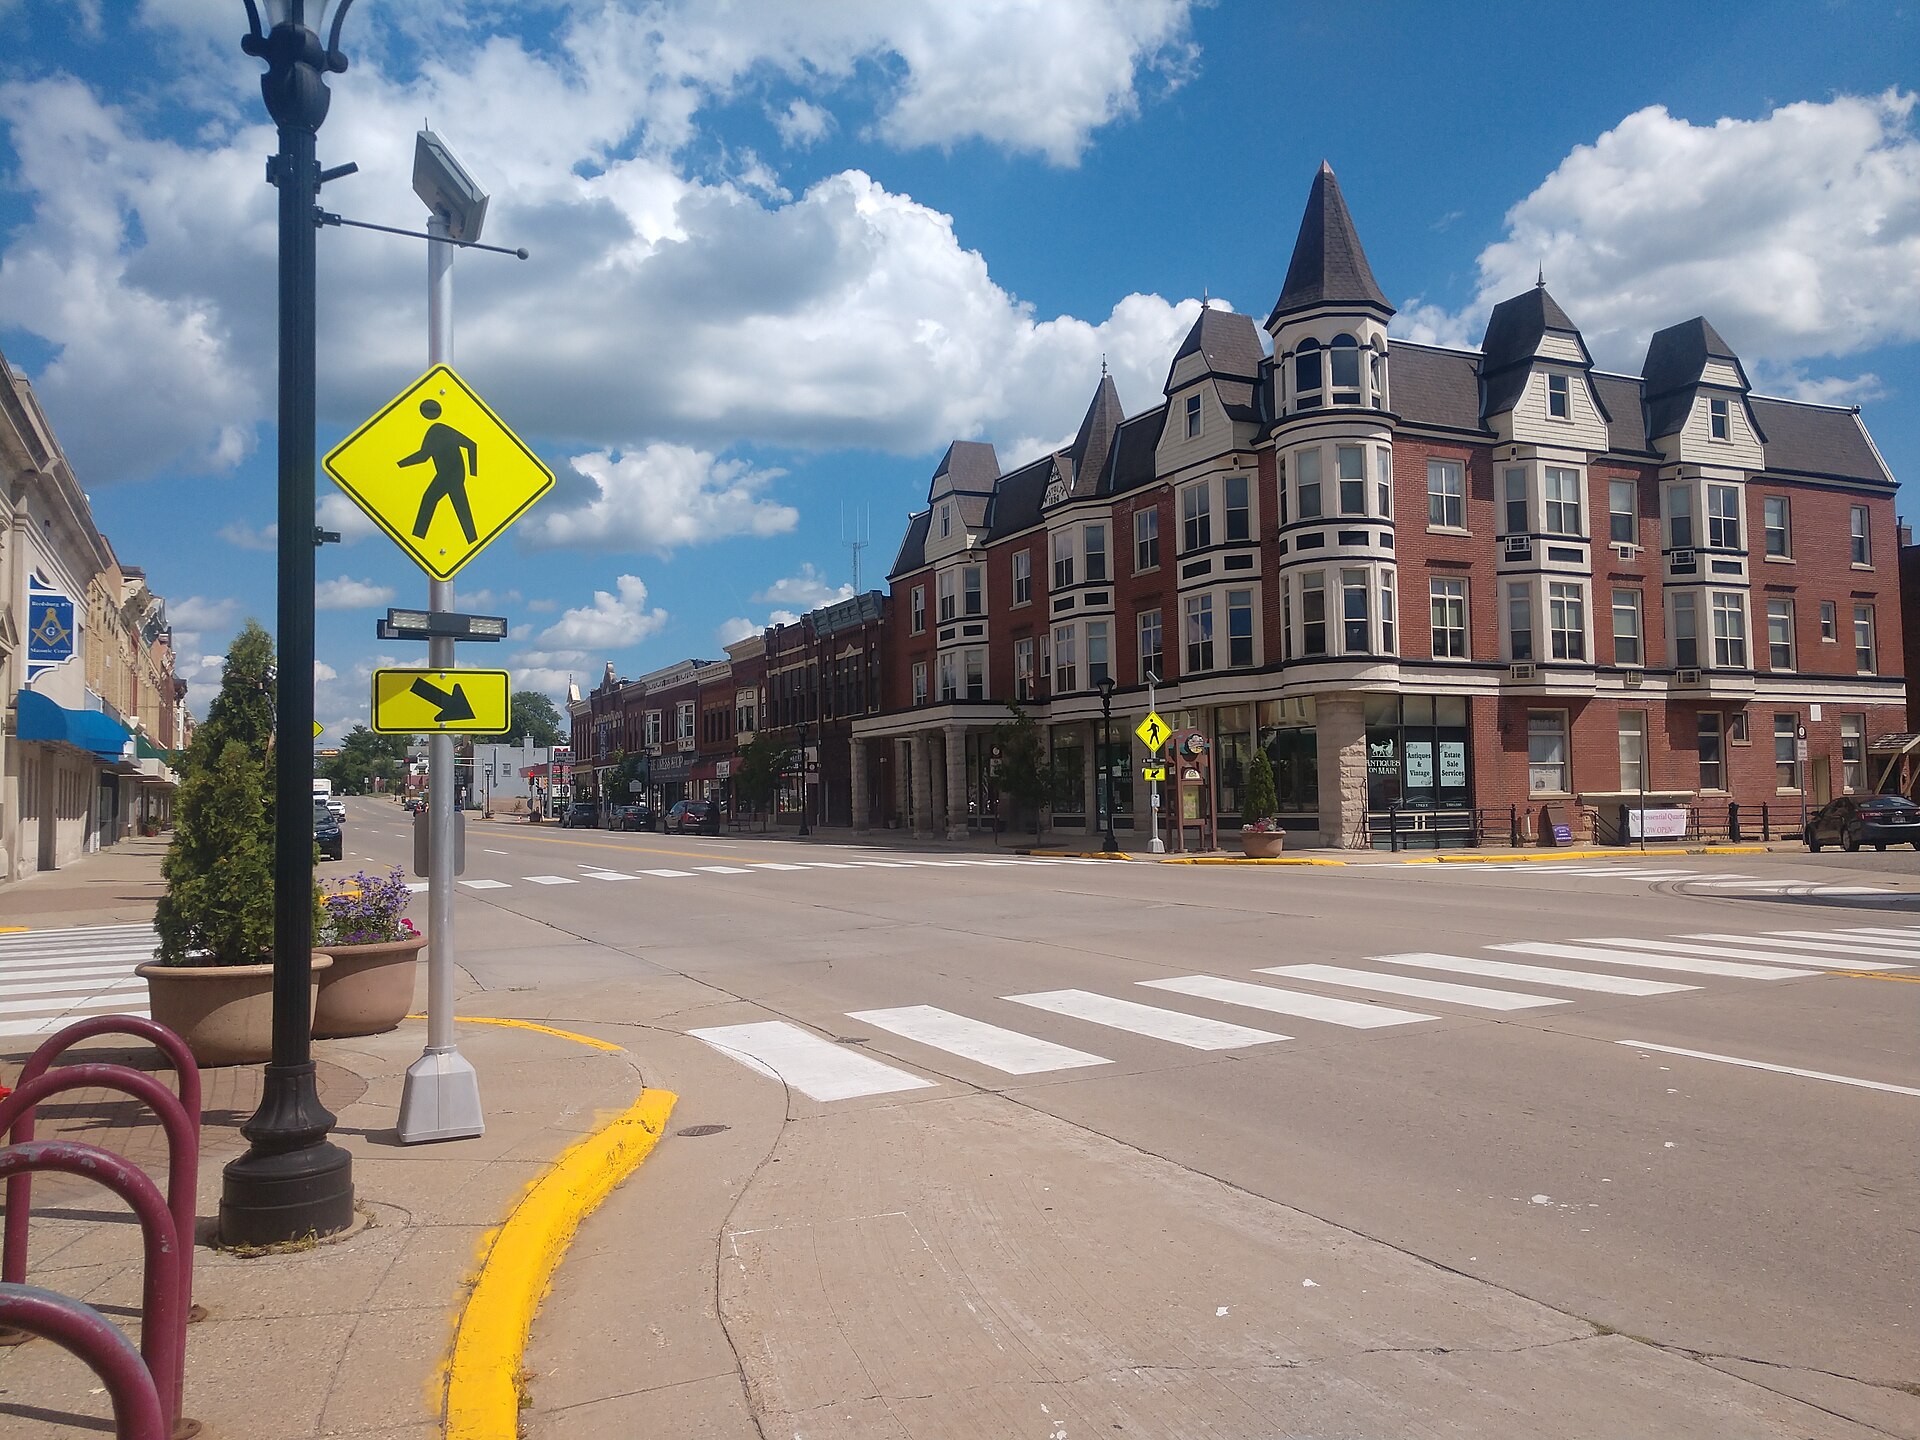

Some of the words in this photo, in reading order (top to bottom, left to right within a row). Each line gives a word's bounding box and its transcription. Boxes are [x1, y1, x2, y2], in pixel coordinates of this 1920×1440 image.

[46, 627, 56, 636] G
[1407, 752, 1432, 760] Antiques
[1444, 751, 1461, 759] Estate
[1367, 759, 1401, 767] ANTIQUES
[1416, 760, 1423, 768] &
[1446, 760, 1459, 768] Sale
[1378, 767, 1398, 775] MAIN
[1409, 769, 1431, 778] Vintage
[1441, 769, 1465, 777] Services
